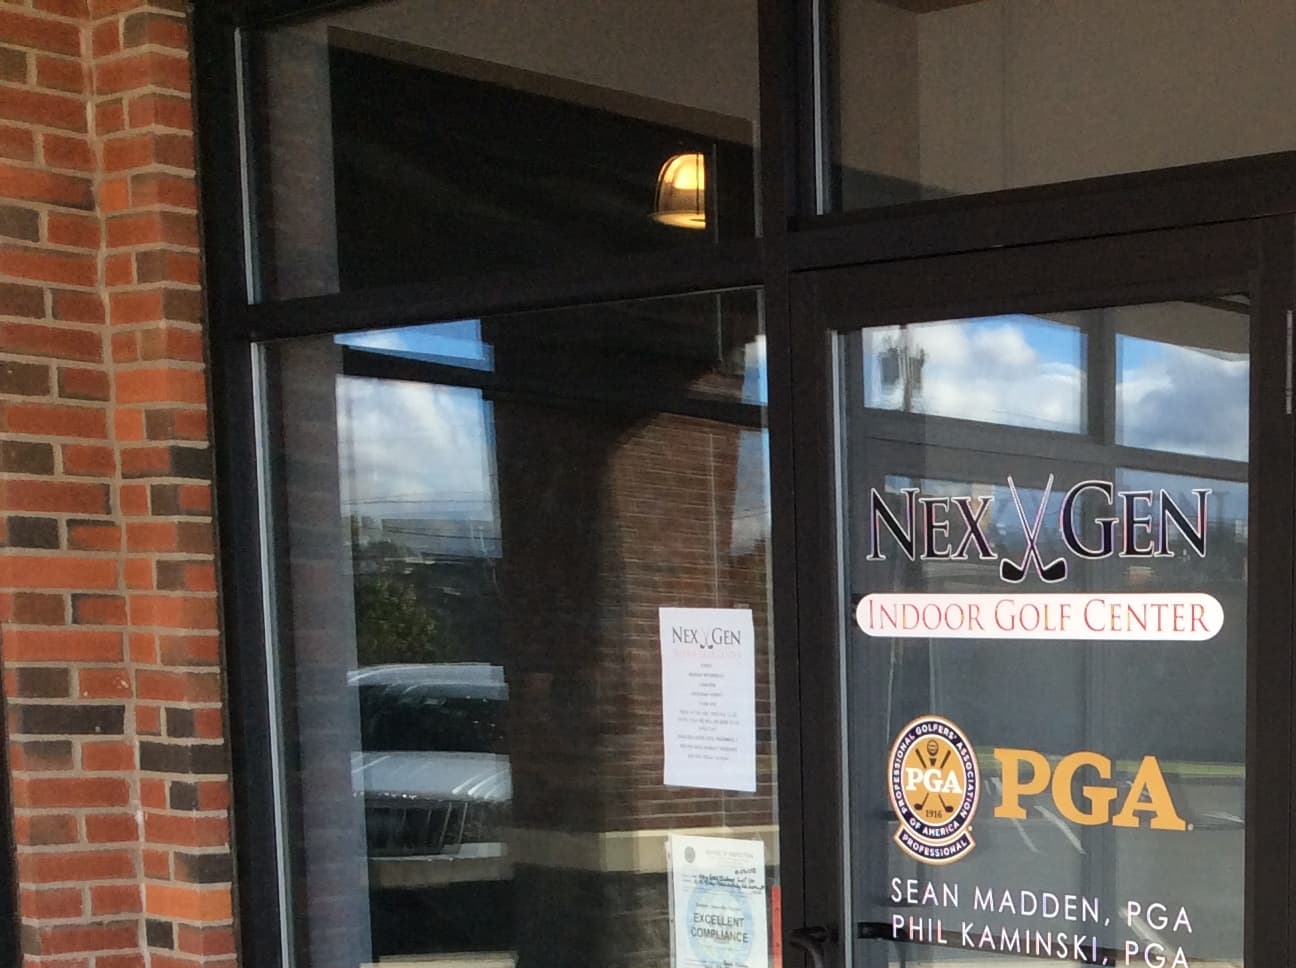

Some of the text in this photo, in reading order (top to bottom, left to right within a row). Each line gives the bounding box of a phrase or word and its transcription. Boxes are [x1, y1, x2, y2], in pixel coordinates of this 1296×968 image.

[1059, 480, 1212, 560] GEN
[868, 598, 1211, 633] INDOOR GOLF CENTER
[671, 626, 741, 645] NEX GEN
[904, 767, 962, 794] PGA
[955, 741, 975, 818] ASSOCIATION
[993, 747, 1187, 832] PGA
[909, 816, 960, 837] OF AMERICA
[925, 809, 943, 819] 1916
[901, 832, 968, 857] PROFESSIONAL
[890, 877, 1193, 934] SEAN MADDEN, PGA
[693, 912, 744, 927] EXCELLENT
[690, 926, 749, 943] COMPLIANCE
[891, 914, 948, 945] PHIL
[961, 921, 1109, 966] KAMINSKI,
